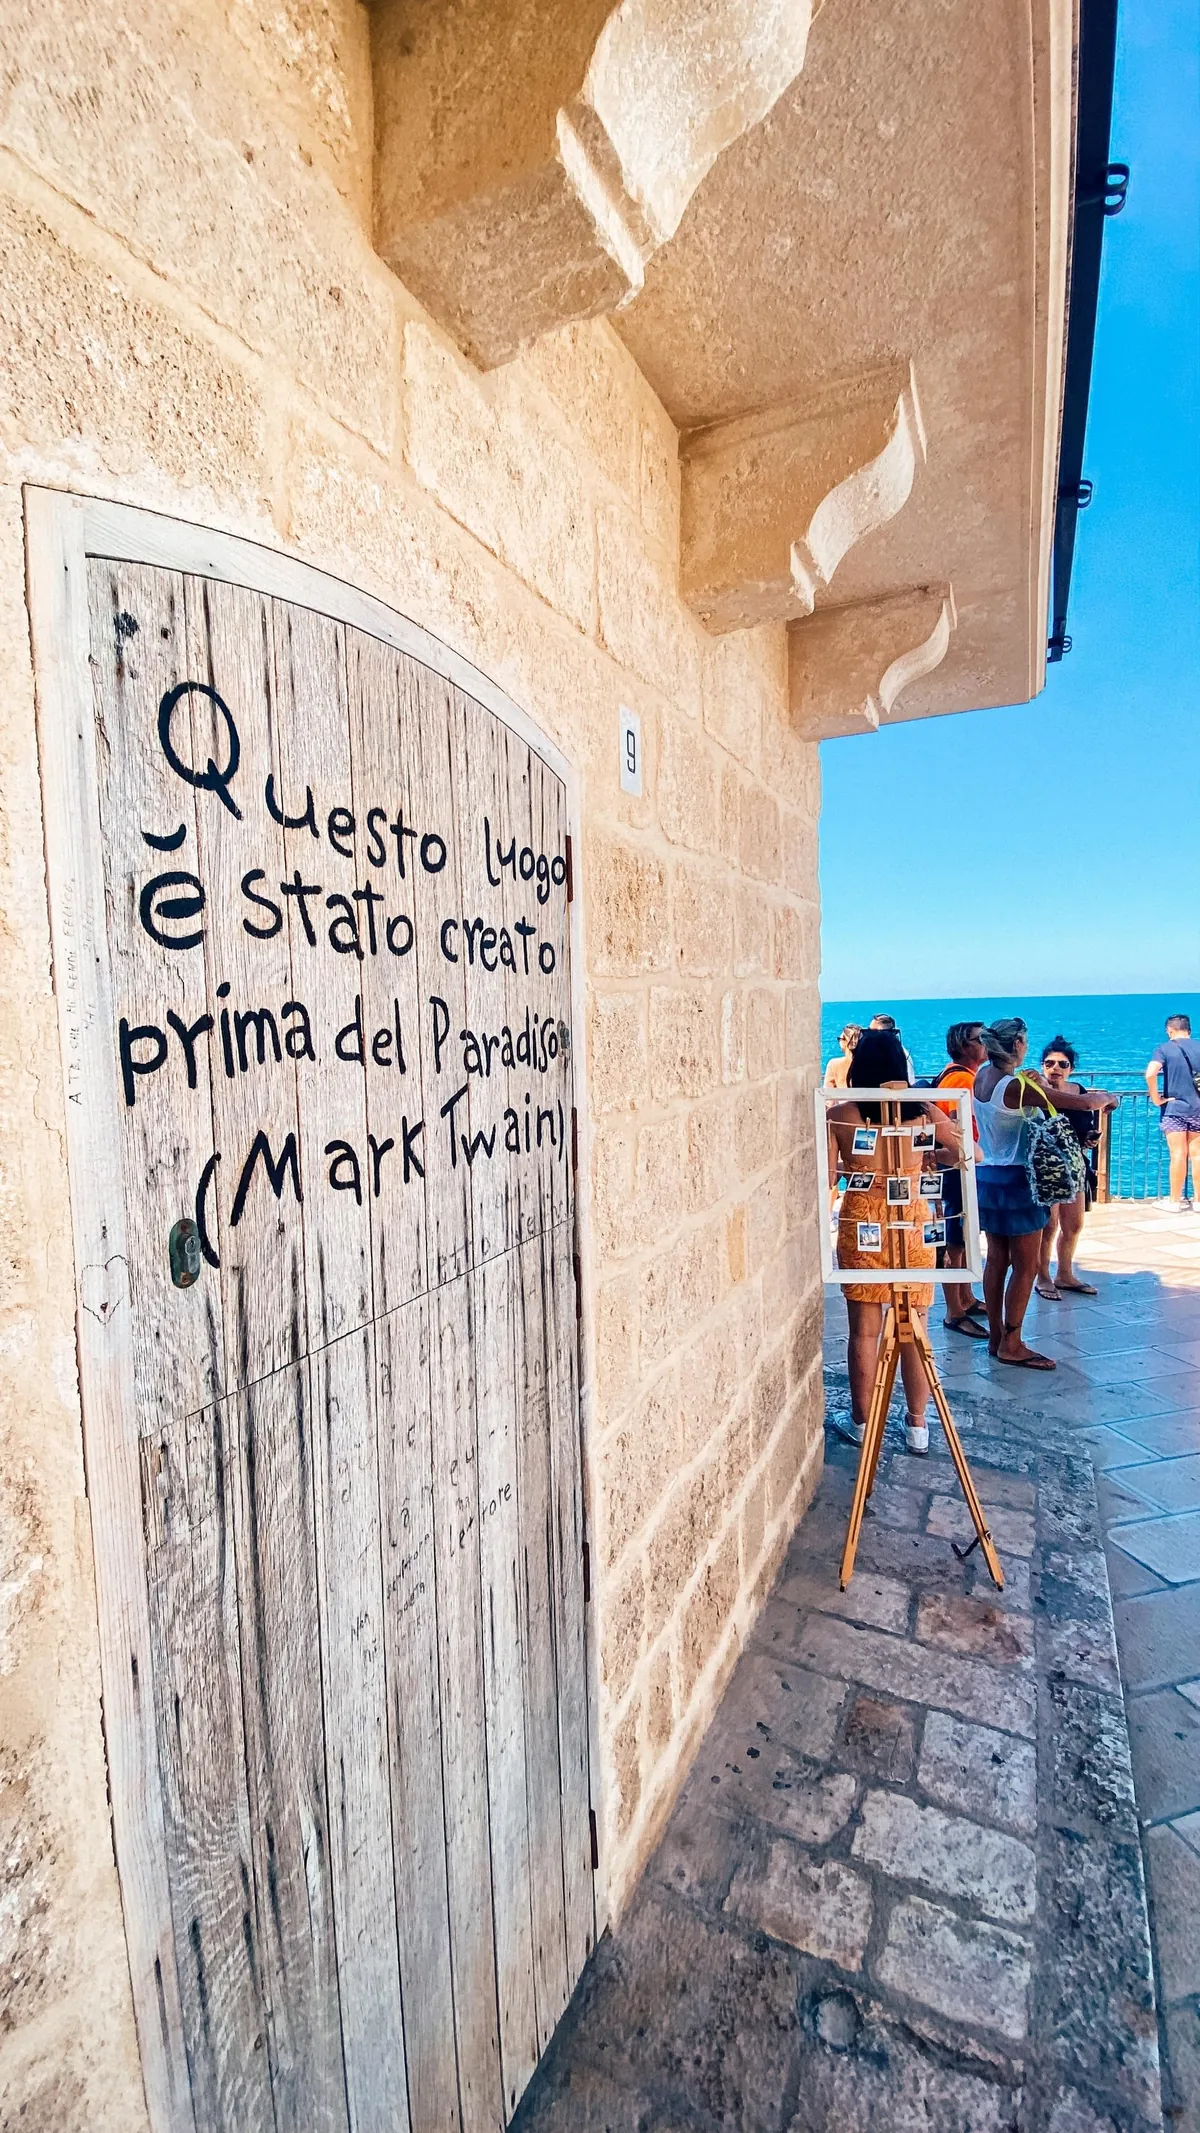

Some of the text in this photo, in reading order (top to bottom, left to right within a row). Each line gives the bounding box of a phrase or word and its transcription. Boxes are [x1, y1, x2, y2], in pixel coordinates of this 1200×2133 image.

[157, 681, 567, 905] Questo luogo
[626, 729, 636, 774] 9
[439, 916, 556, 977] creato
[119, 981, 560, 1108] prima del Paradiso
[196, 1115, 426, 1270] (Mark
[440, 1082, 564, 1171] Twain)
